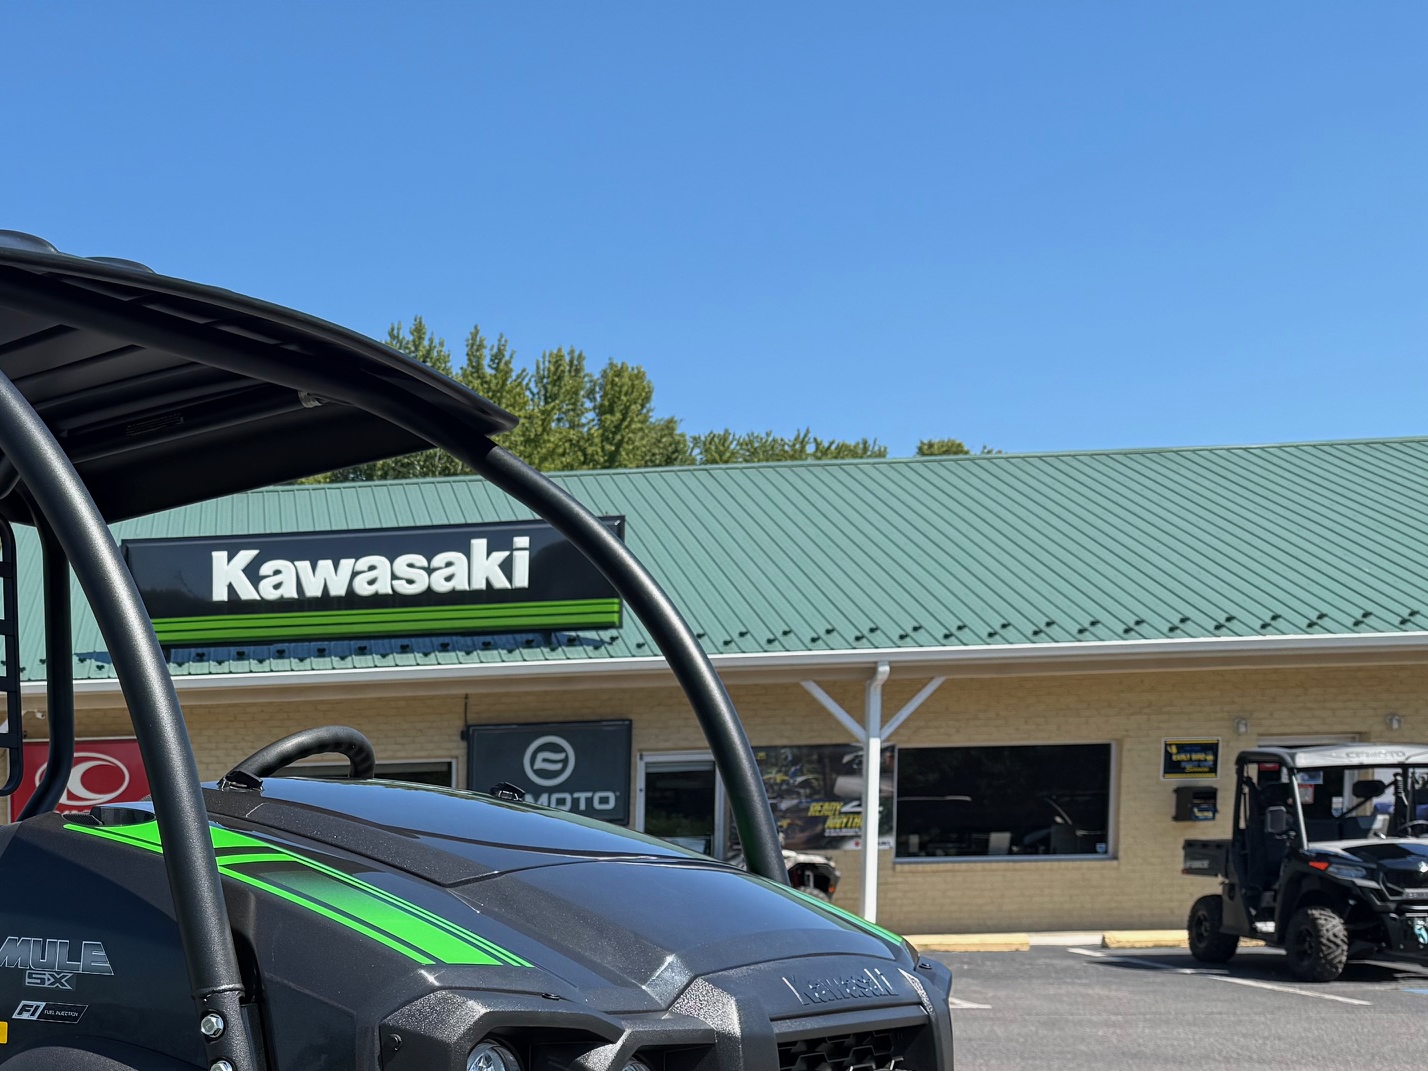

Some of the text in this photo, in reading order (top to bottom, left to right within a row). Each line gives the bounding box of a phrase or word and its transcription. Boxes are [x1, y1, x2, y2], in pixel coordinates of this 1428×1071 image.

[211, 536, 530, 602] Kawasaki
[25, 971, 74, 989] SX
[15, 1004, 40, 1018] FI
